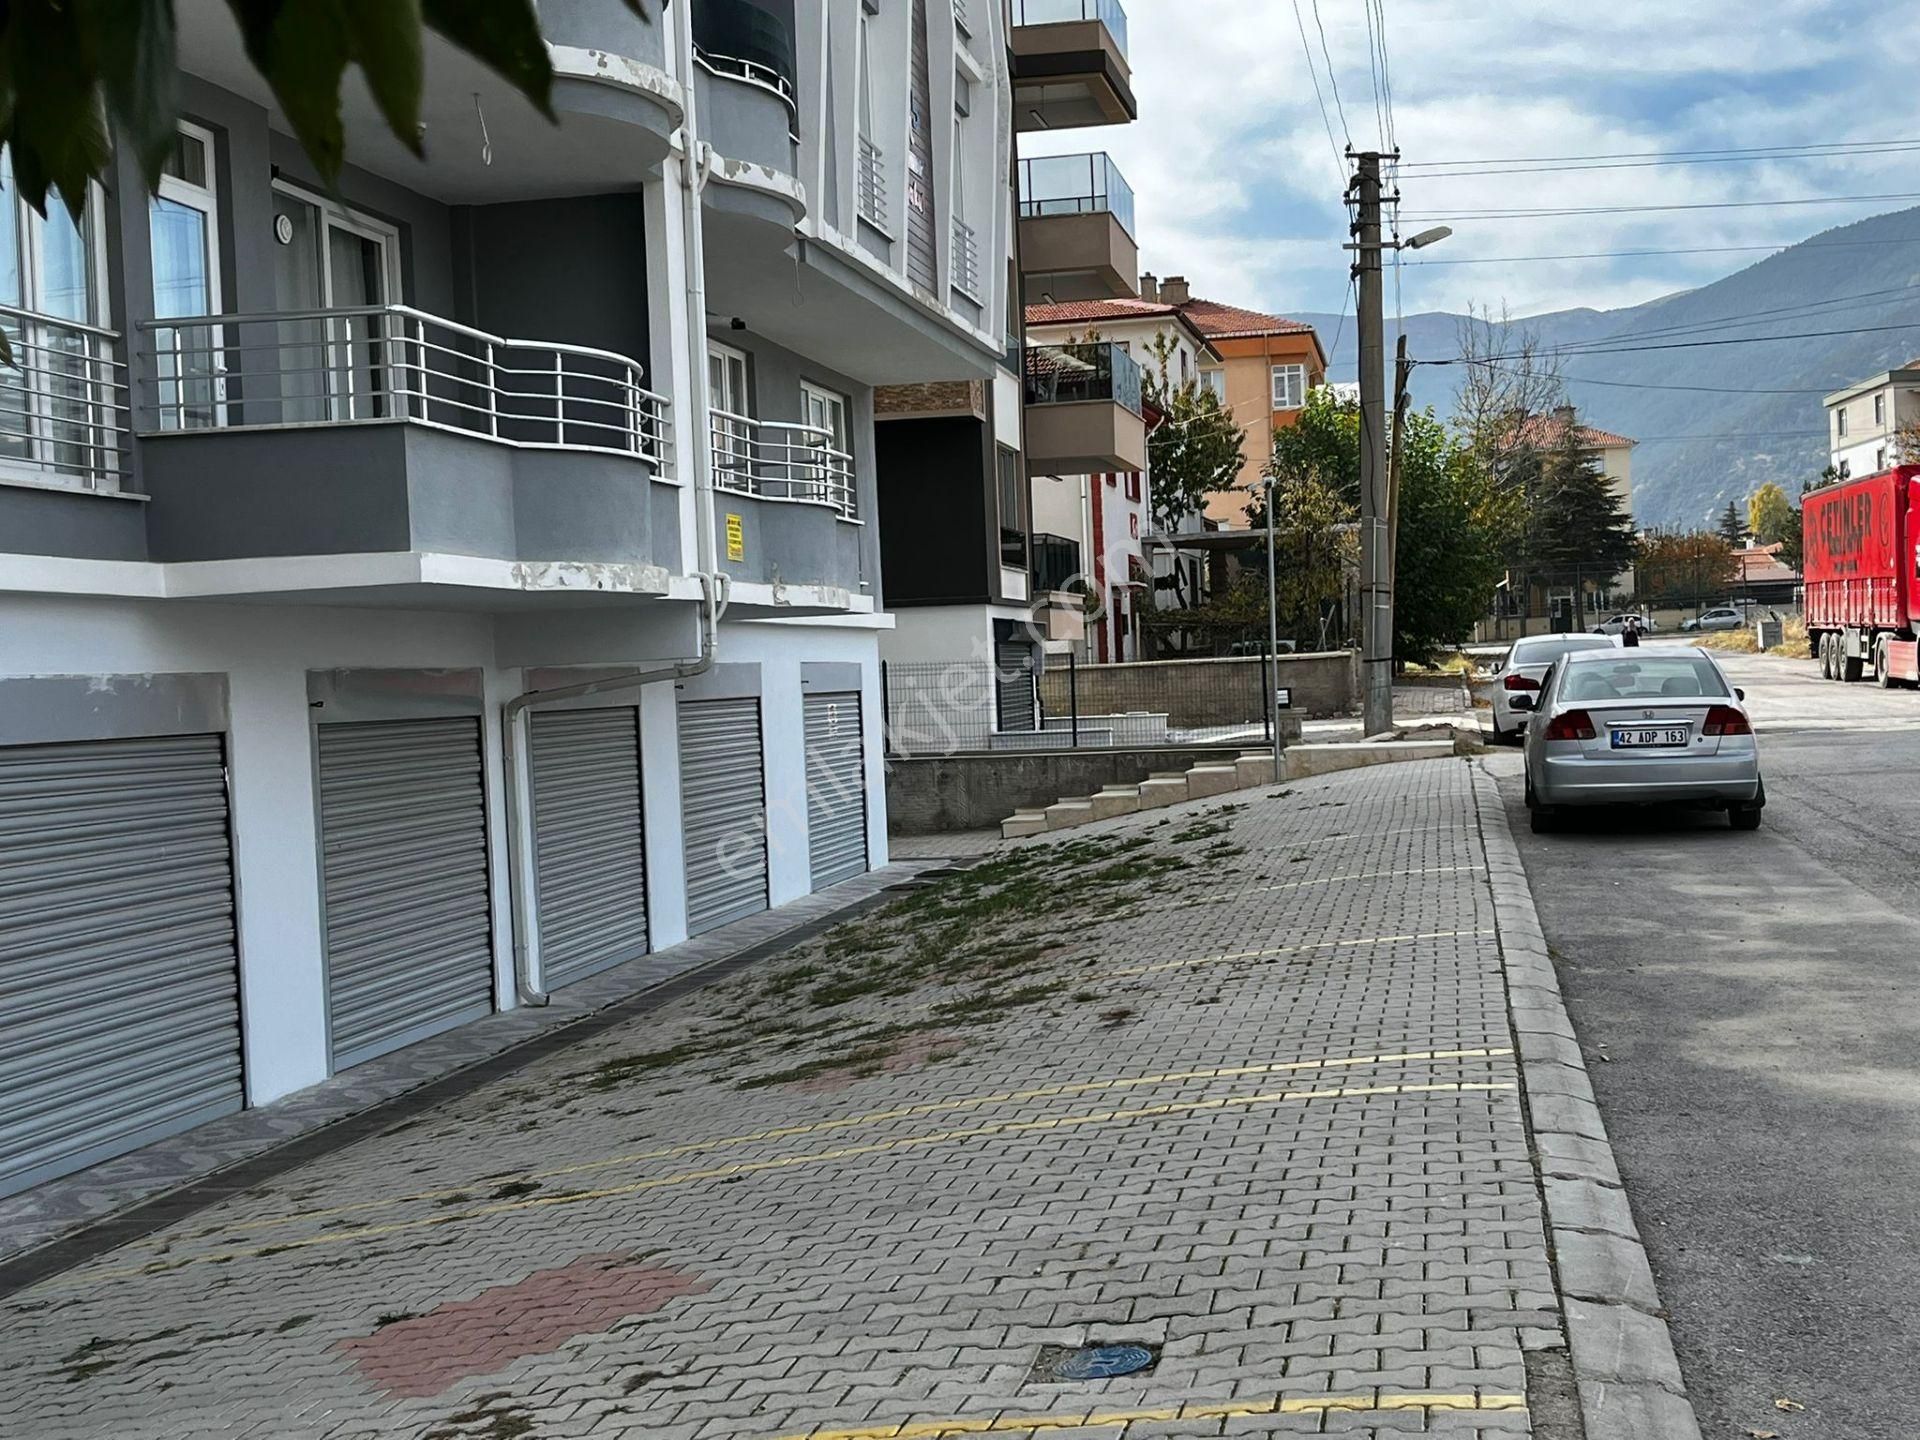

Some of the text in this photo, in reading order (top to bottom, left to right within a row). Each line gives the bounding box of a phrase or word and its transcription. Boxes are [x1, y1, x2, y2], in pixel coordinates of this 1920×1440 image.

[1619, 731, 1684, 744] 42 ADP 163
